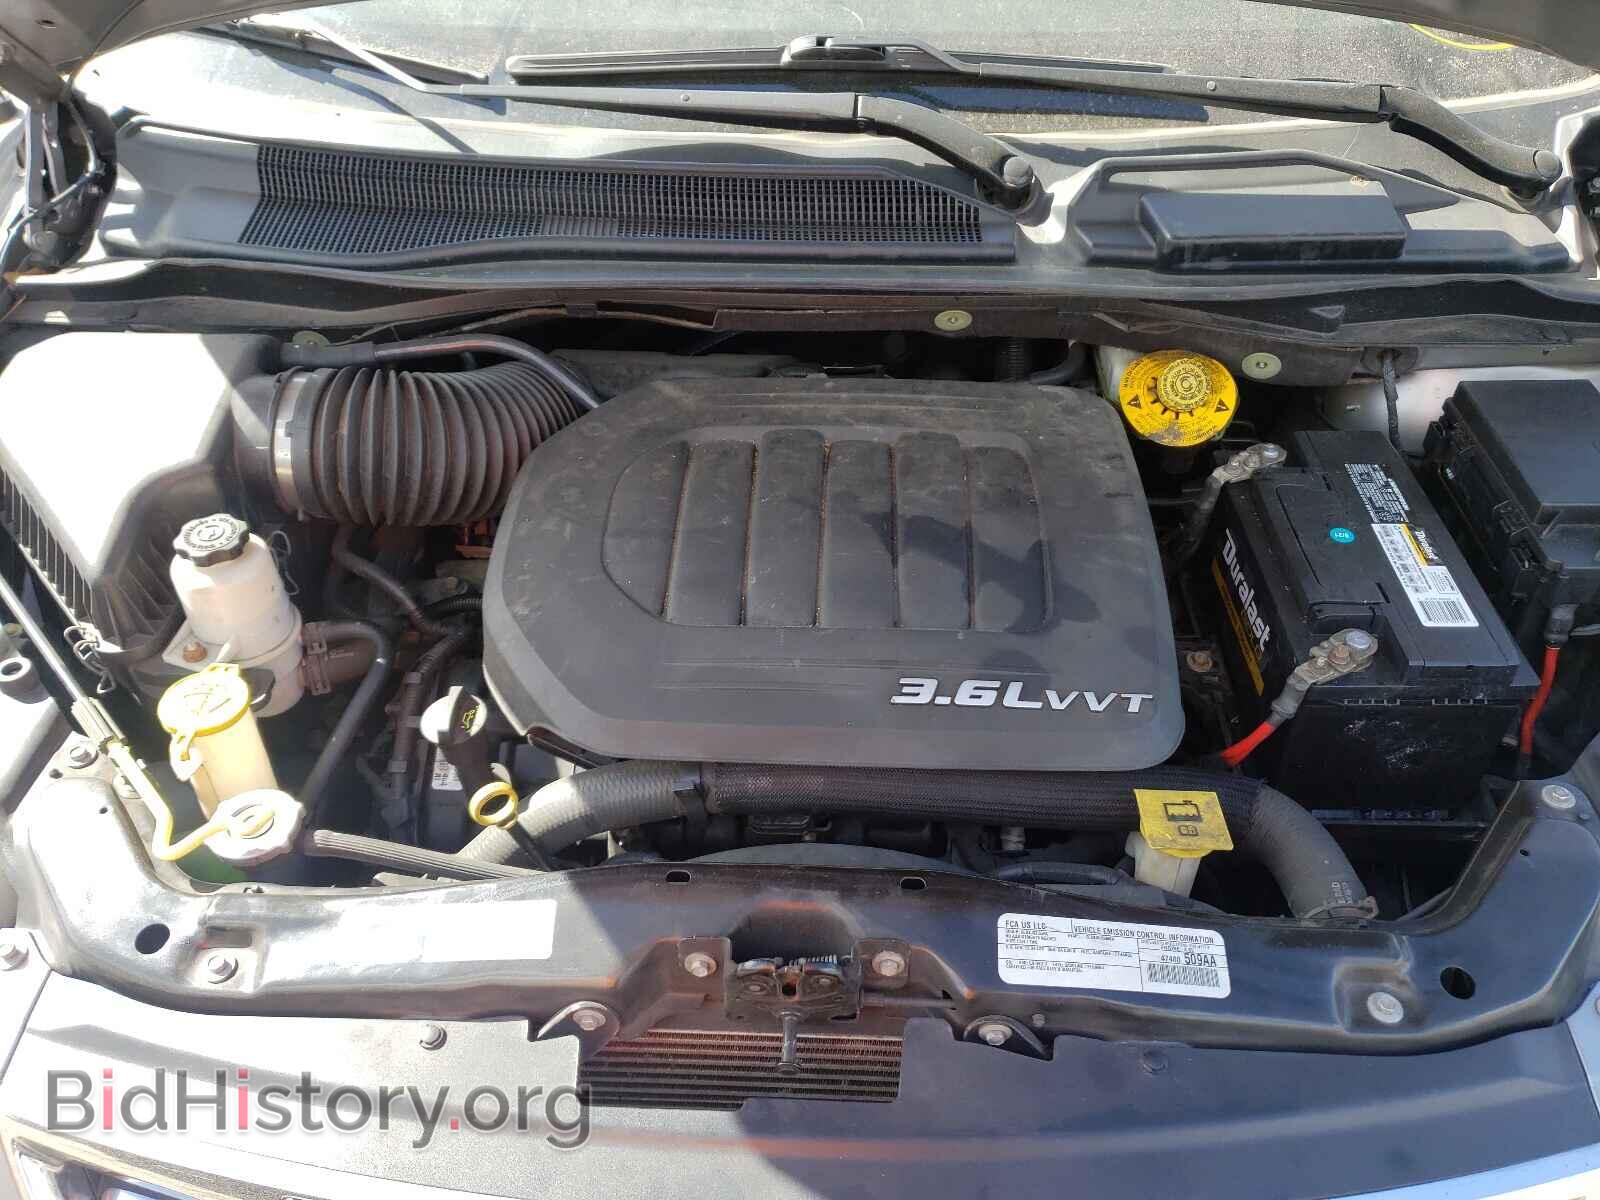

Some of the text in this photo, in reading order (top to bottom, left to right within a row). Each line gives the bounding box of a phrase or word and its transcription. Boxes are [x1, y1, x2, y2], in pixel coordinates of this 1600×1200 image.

[1222, 527, 1271, 654] Duralast
[891, 677, 1154, 714] 3.6L VVT
[1005, 919, 1214, 944] FCA US LLC VEHICLE EMISSION CONTROL INFORMATION
[1184, 952, 1217, 967] 509AA
